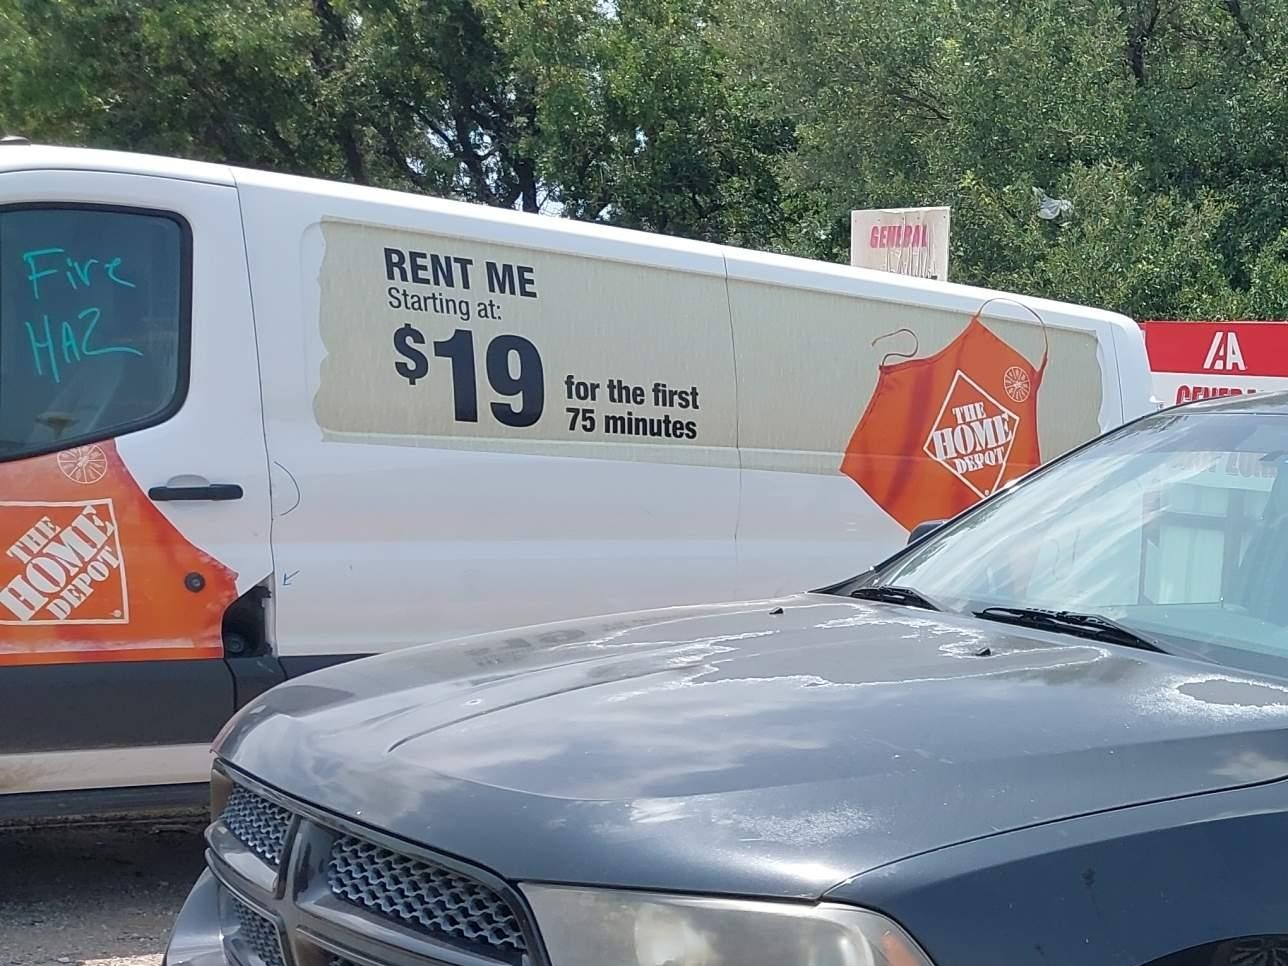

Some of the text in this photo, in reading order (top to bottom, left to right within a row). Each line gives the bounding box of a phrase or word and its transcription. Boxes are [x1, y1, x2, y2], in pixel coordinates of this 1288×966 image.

[869, 224, 928, 249] GENERAL
[23, 248, 136, 299] Fire
[384, 247, 537, 299] RENT ME
[387, 286, 502, 321] Starting at:
[393, 323, 545, 428] $19
[564, 374, 700, 410] for the first
[566, 406, 698, 440] 75 minutes
[933, 412, 1012, 461] HOME
[952, 402, 987, 424] THE
[954, 447, 1005, 475] DEPOT
[0, 505, 116, 621] HOME
[6, 516, 61, 564] THE
[47, 546, 121, 620] DEPOT
